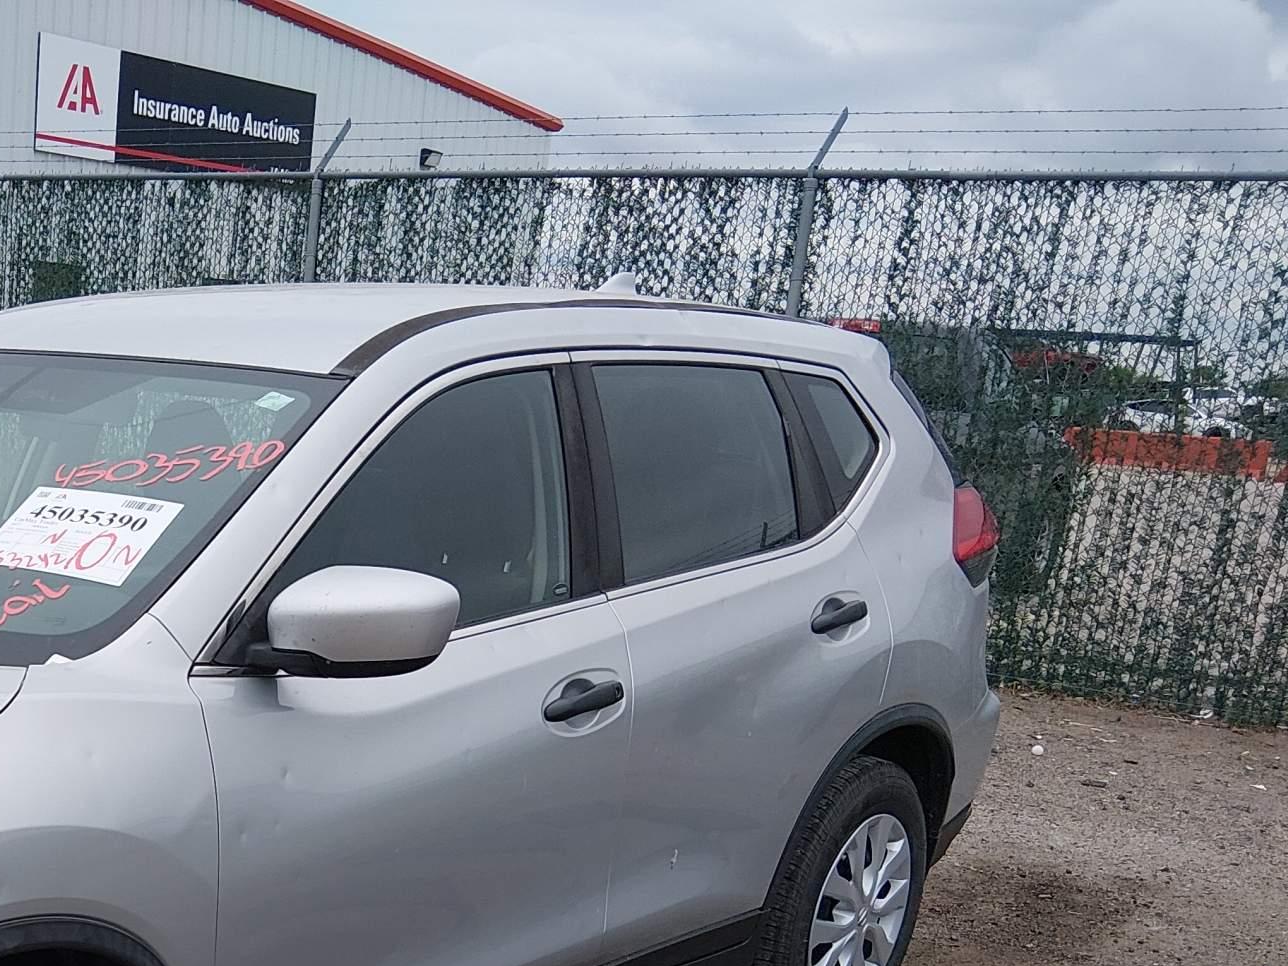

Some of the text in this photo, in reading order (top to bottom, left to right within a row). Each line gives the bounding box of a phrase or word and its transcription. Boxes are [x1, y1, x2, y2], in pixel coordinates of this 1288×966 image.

[133, 89, 301, 145] Insurance Auto Auctions
[55, 439, 285, 488] 45035390
[30, 504, 149, 532] 45035390
